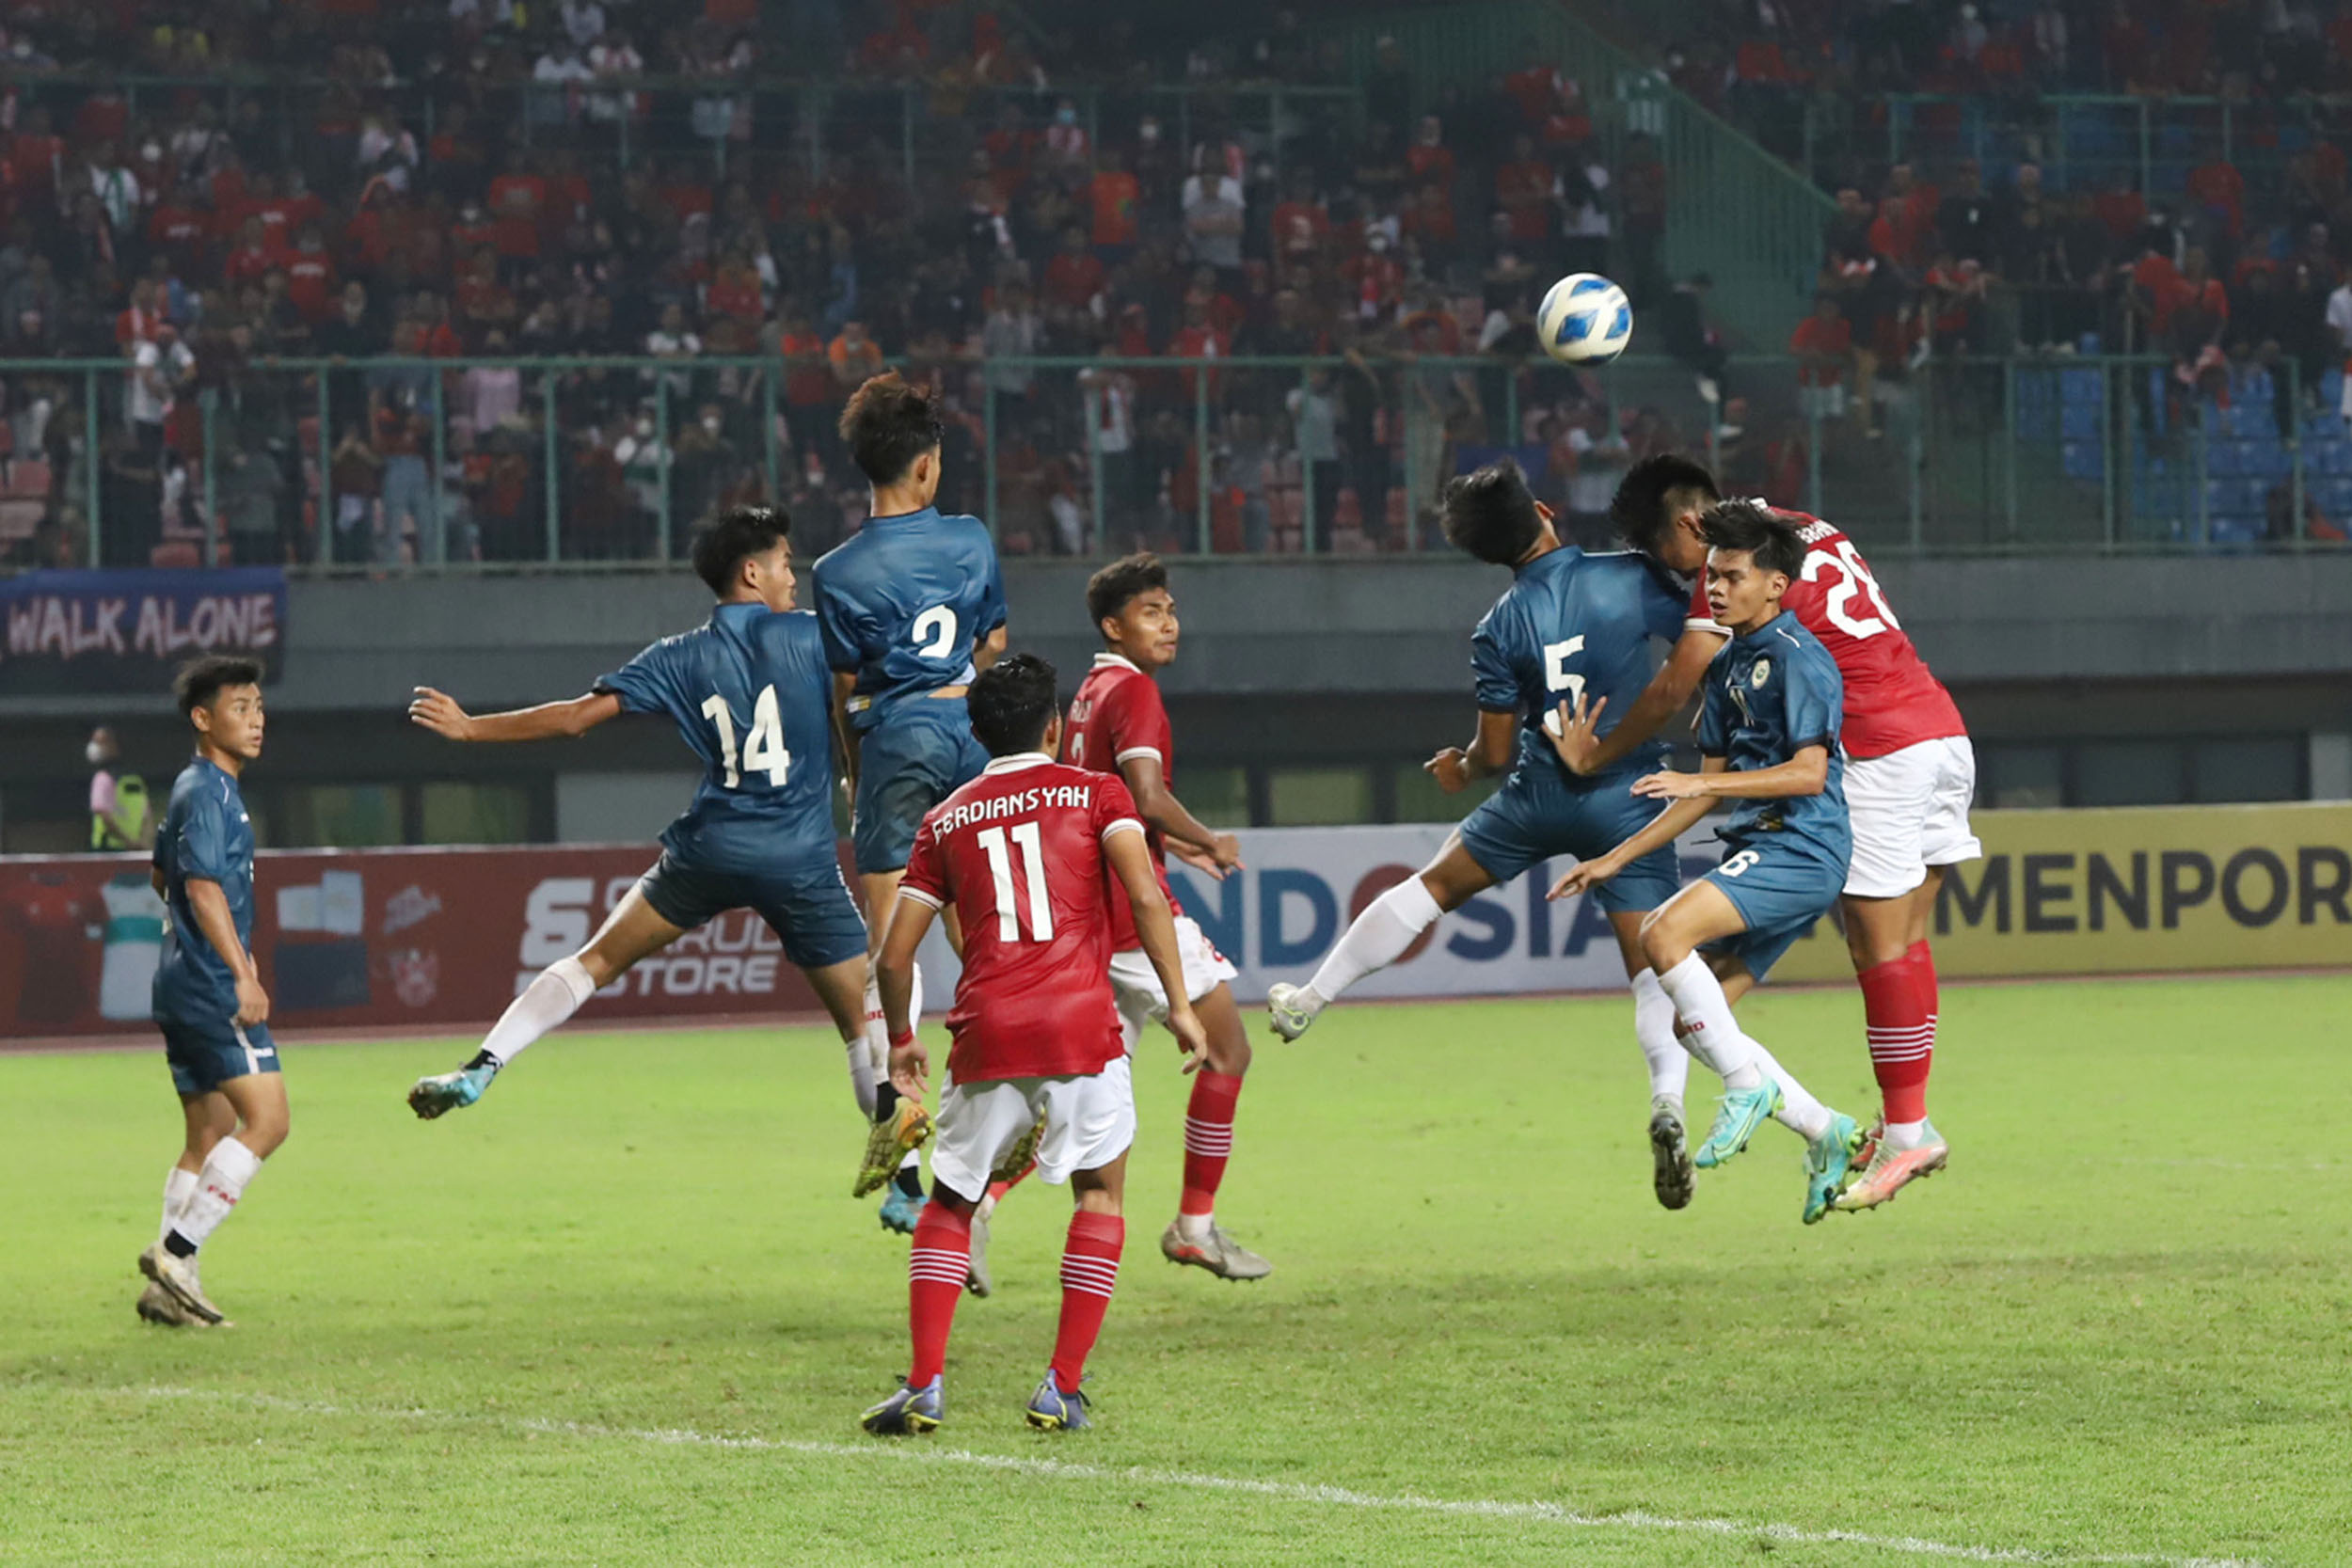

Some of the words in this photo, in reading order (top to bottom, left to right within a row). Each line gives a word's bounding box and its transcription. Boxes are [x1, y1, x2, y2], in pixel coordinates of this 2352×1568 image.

[8, 596, 125, 659] WALK
[134, 594, 278, 658] ALONE
[701, 683, 790, 788] 14
[1544, 634, 1586, 736] 5
[930, 785, 1090, 845] FERDIANSYAH
[977, 820, 1054, 942] 11
